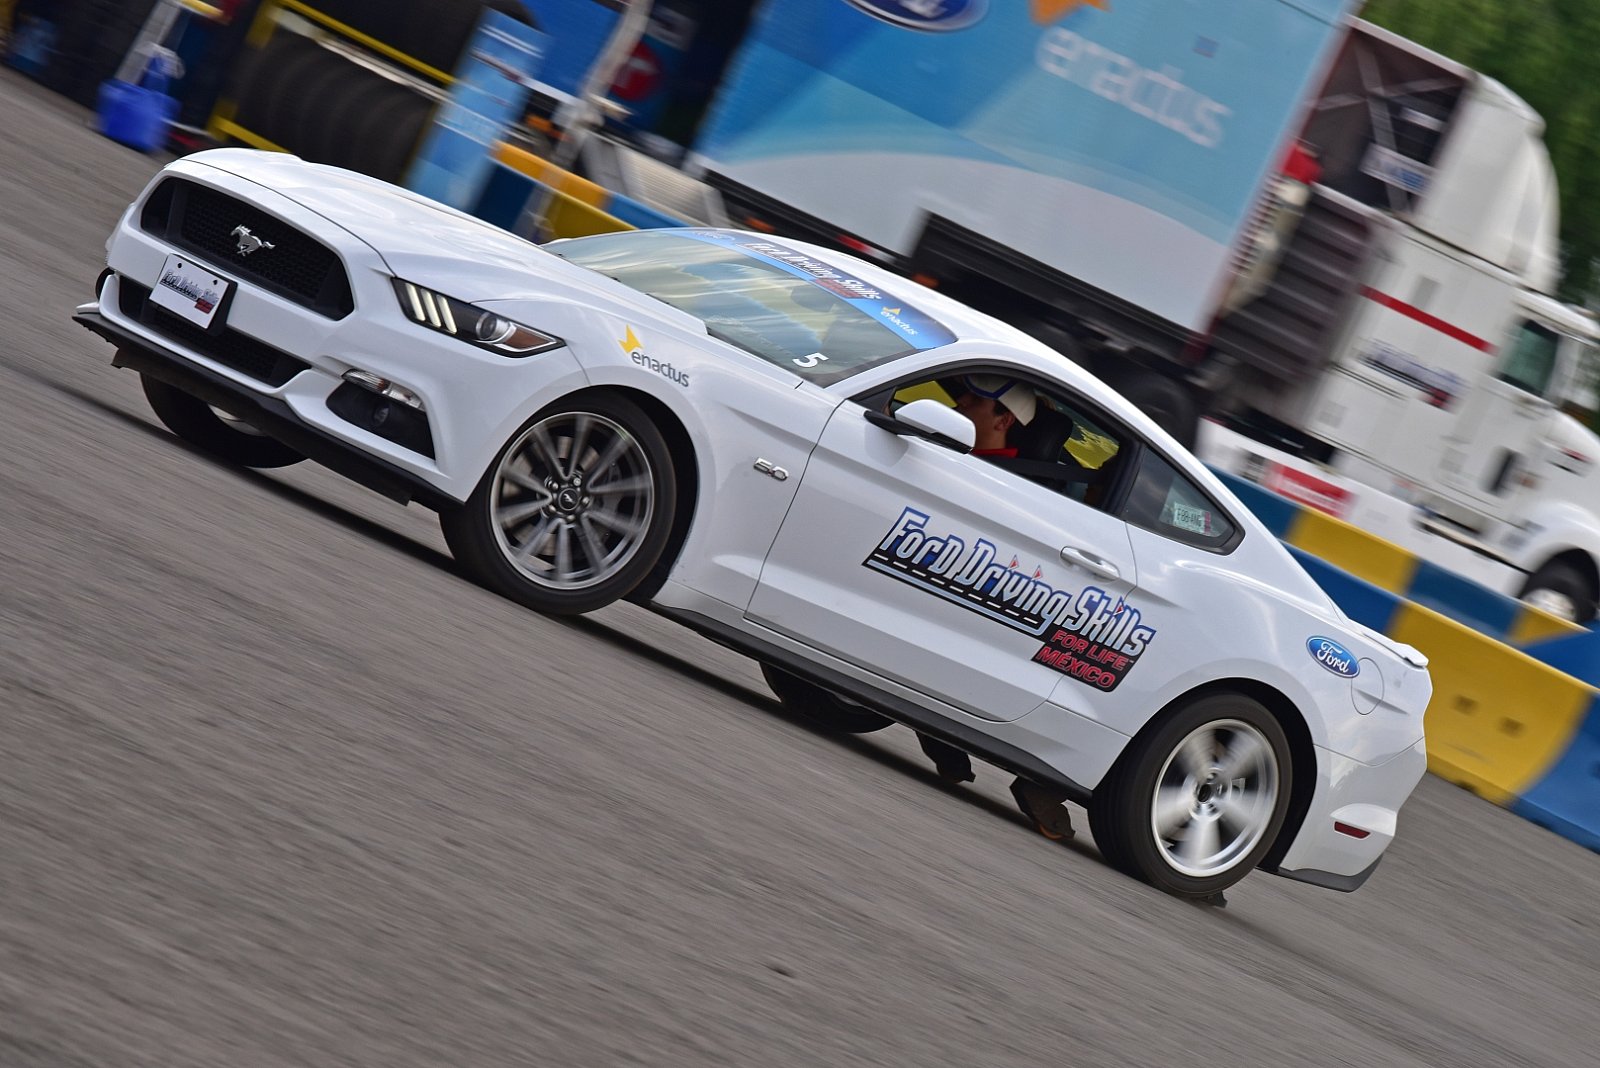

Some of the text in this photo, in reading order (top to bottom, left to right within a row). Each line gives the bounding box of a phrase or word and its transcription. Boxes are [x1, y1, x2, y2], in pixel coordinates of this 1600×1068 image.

[880, 310, 919, 335] enactus
[630, 350, 690, 388] enactus
[791, 352, 829, 368] 5
[753, 457, 789, 482] 5.0
[951, 538, 1073, 634] Driving
[1062, 586, 1157, 657] Skills
[1035, 646, 1116, 688] MÉXICO
[1052, 629, 1130, 671] FOR LIFE
[1316, 641, 1351, 673] Ford
